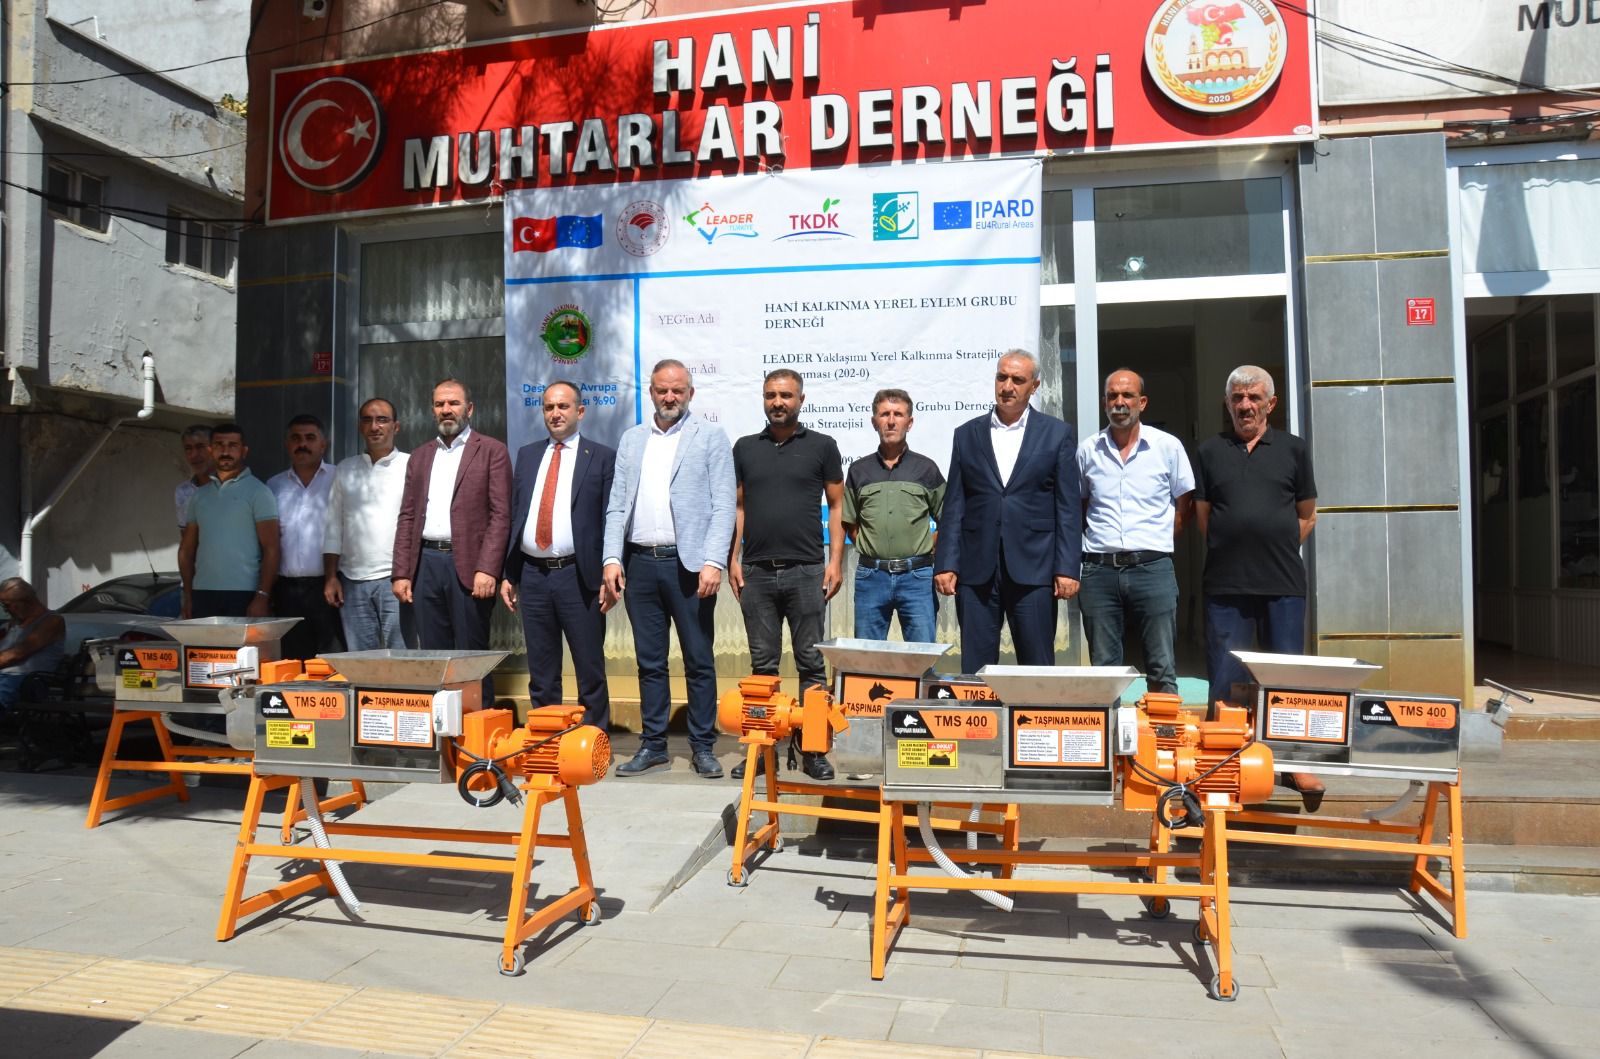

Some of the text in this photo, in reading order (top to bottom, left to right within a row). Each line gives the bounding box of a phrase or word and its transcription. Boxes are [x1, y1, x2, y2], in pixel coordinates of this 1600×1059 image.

[652, 11, 820, 95] HANİ
[1208, 95, 1231, 104] 2020
[403, 53, 1114, 191] MUHTARLAR DERNEĞİ
[976, 199, 1034, 218] IPARD
[706, 213, 753, 225] LEADER
[789, 212, 839, 230] TKDK
[976, 220, 1034, 230] EU4Rural Areas
[764, 295, 1018, 313] HANİ KALKINMA YEREL EYLEM GRUBU
[697, 312, 715, 324] Adı
[1414, 308, 1428, 320] 17
[764, 315, 825, 330] DERNEĞİ
[763, 348, 1003, 365] LEADER Yaklaşımı Yerel Kalkınma Stratejile
[700, 363, 717, 374] Adı
[834, 367, 870, 380] (202-0)
[580, 383, 617, 394] Avrupa
[592, 395, 616, 406] %90
[799, 400, 994, 413] alkınma Yere Grubu Derneğ
[817, 418, 864, 431] Stratejisi
[142, 652, 173, 662] TMS 400
[963, 690, 986, 700] TMS
[294, 696, 337, 708] TMS 400
[374, 697, 430, 708] TAŞPINAR MAKİNA
[1285, 697, 1343, 708] TAŞPINAR MAKİNA
[846, 702, 882, 715] TAŞPINAR
[1399, 705, 1447, 718] TMS 400
[934, 715, 988, 727] TMS 400
[1034, 714, 1101, 728] TAŞPINAR MAKİNA
